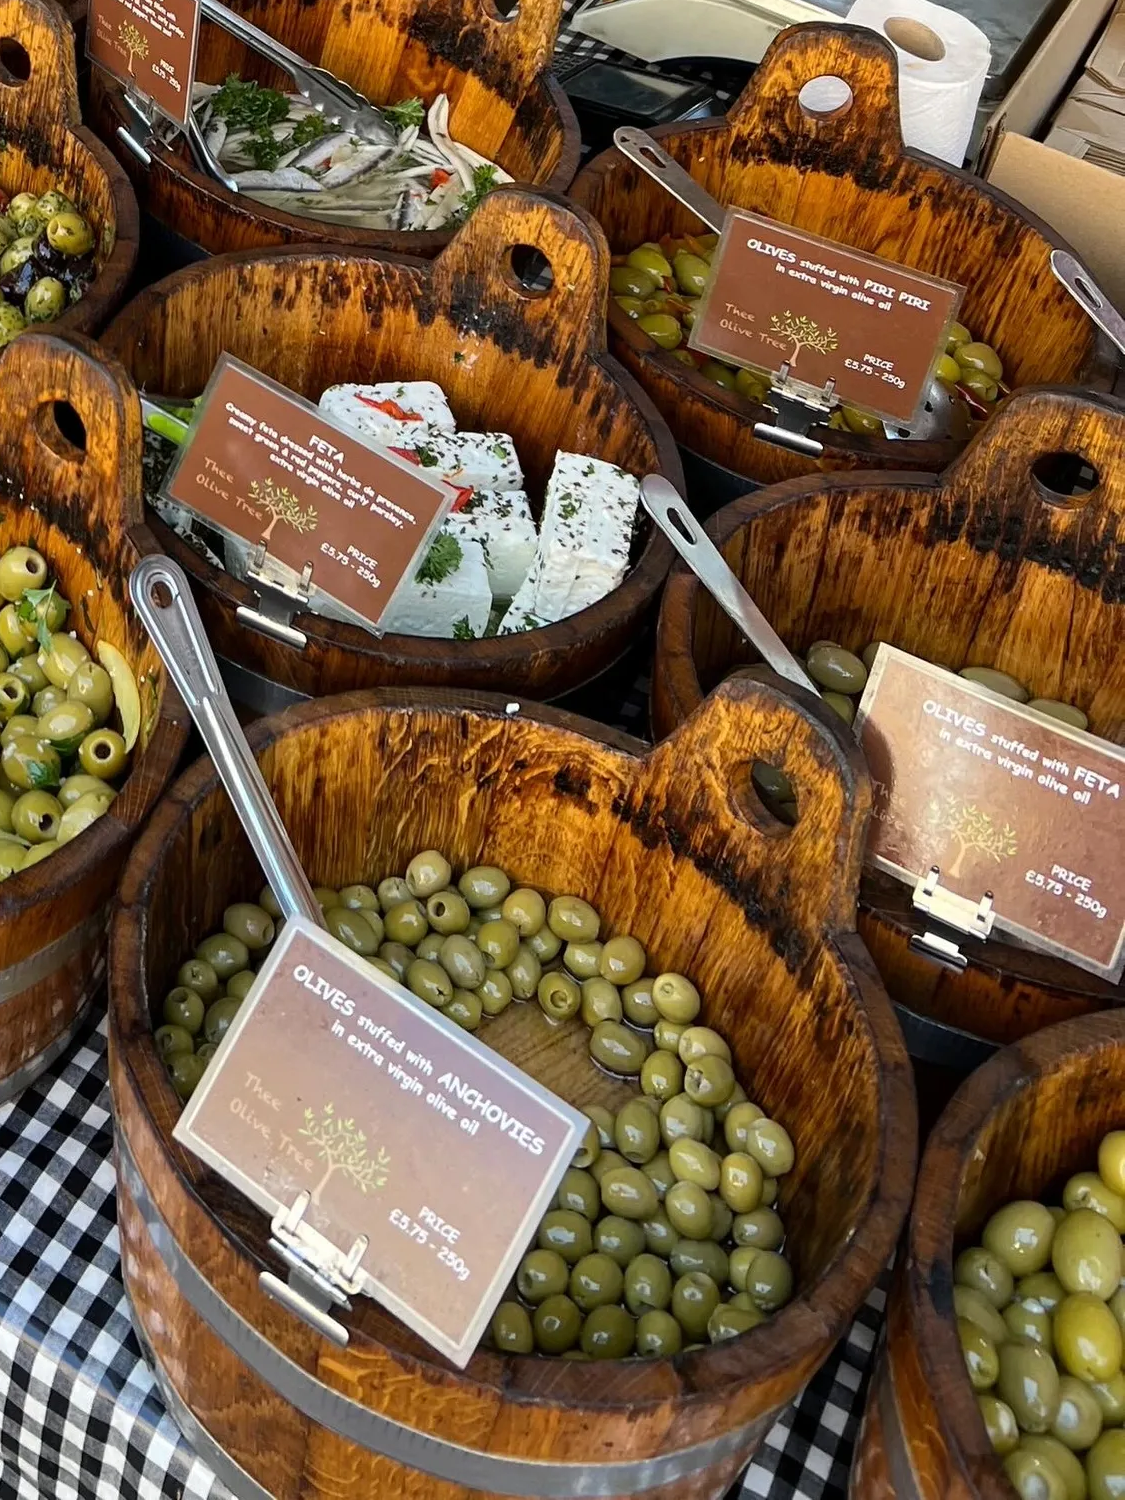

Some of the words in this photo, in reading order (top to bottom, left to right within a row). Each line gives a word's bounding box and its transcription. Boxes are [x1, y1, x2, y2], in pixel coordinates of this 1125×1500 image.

[746, 238, 796, 263] OLIVES
[799, 259, 837, 278] stuffed
[838, 273, 860, 286] with
[863, 279, 896, 298] PIRI
[898, 292, 931, 311] PIRI
[775, 262, 785, 273] in
[788, 268, 817, 284] extra
[819, 279, 848, 297] virgin
[851, 291, 875, 305] olive
[877, 301, 892, 311] oil
[844, 358, 873, 375] £5.75
[881, 372, 906, 389] 250g
[863, 353, 894, 371] PRICE
[224, 401, 257, 426] Creamy
[258, 422, 278, 439] feta
[279, 435, 315, 460] dressed
[314, 456, 335, 473] with
[335, 468, 361, 489] herbs
[362, 485, 375, 497] de
[228, 416, 254, 435] sweet
[253, 432, 280, 452] green
[290, 453, 307, 468] red
[346, 488, 370, 507] curly
[308, 434, 345, 464] FETA
[269, 453, 294, 472] extra
[295, 468, 320, 489] virgin
[320, 484, 341, 500] olive
[342, 497, 355, 509] oil
[319, 542, 349, 566] £5.75
[355, 566, 381, 588] 250g
[346, 545, 378, 570] PRICE
[922, 699, 987, 737] OLIVES
[990, 733, 1039, 761] stuffed
[1041, 756, 1070, 776] with
[1073, 766, 1121, 799] FETA
[938, 727, 951, 741] in
[954, 735, 993, 760] extra
[996, 754, 1034, 780] virgin
[1037, 773, 1069, 794] olive
[1072, 789, 1091, 804] oil
[1024, 869, 1064, 896] £5.75
[1073, 893, 1108, 919] 250g
[1050, 864, 1092, 892] PRICE
[292, 963, 357, 1017] OLIVES
[356, 1014, 406, 1054] stuffed
[405, 1049, 434, 1076] with
[436, 1070, 546, 1156] ANCHOVIES
[330, 1019, 346, 1037] in
[346, 1033, 384, 1066] extra
[386, 1061, 424, 1097] virgin
[425, 1090, 458, 1120] olive
[459, 1116, 480, 1136] oil
[388, 1208, 429, 1245] £5.75
[436, 1245, 471, 1282] 250g
[418, 1205, 460, 1245] PRICE
